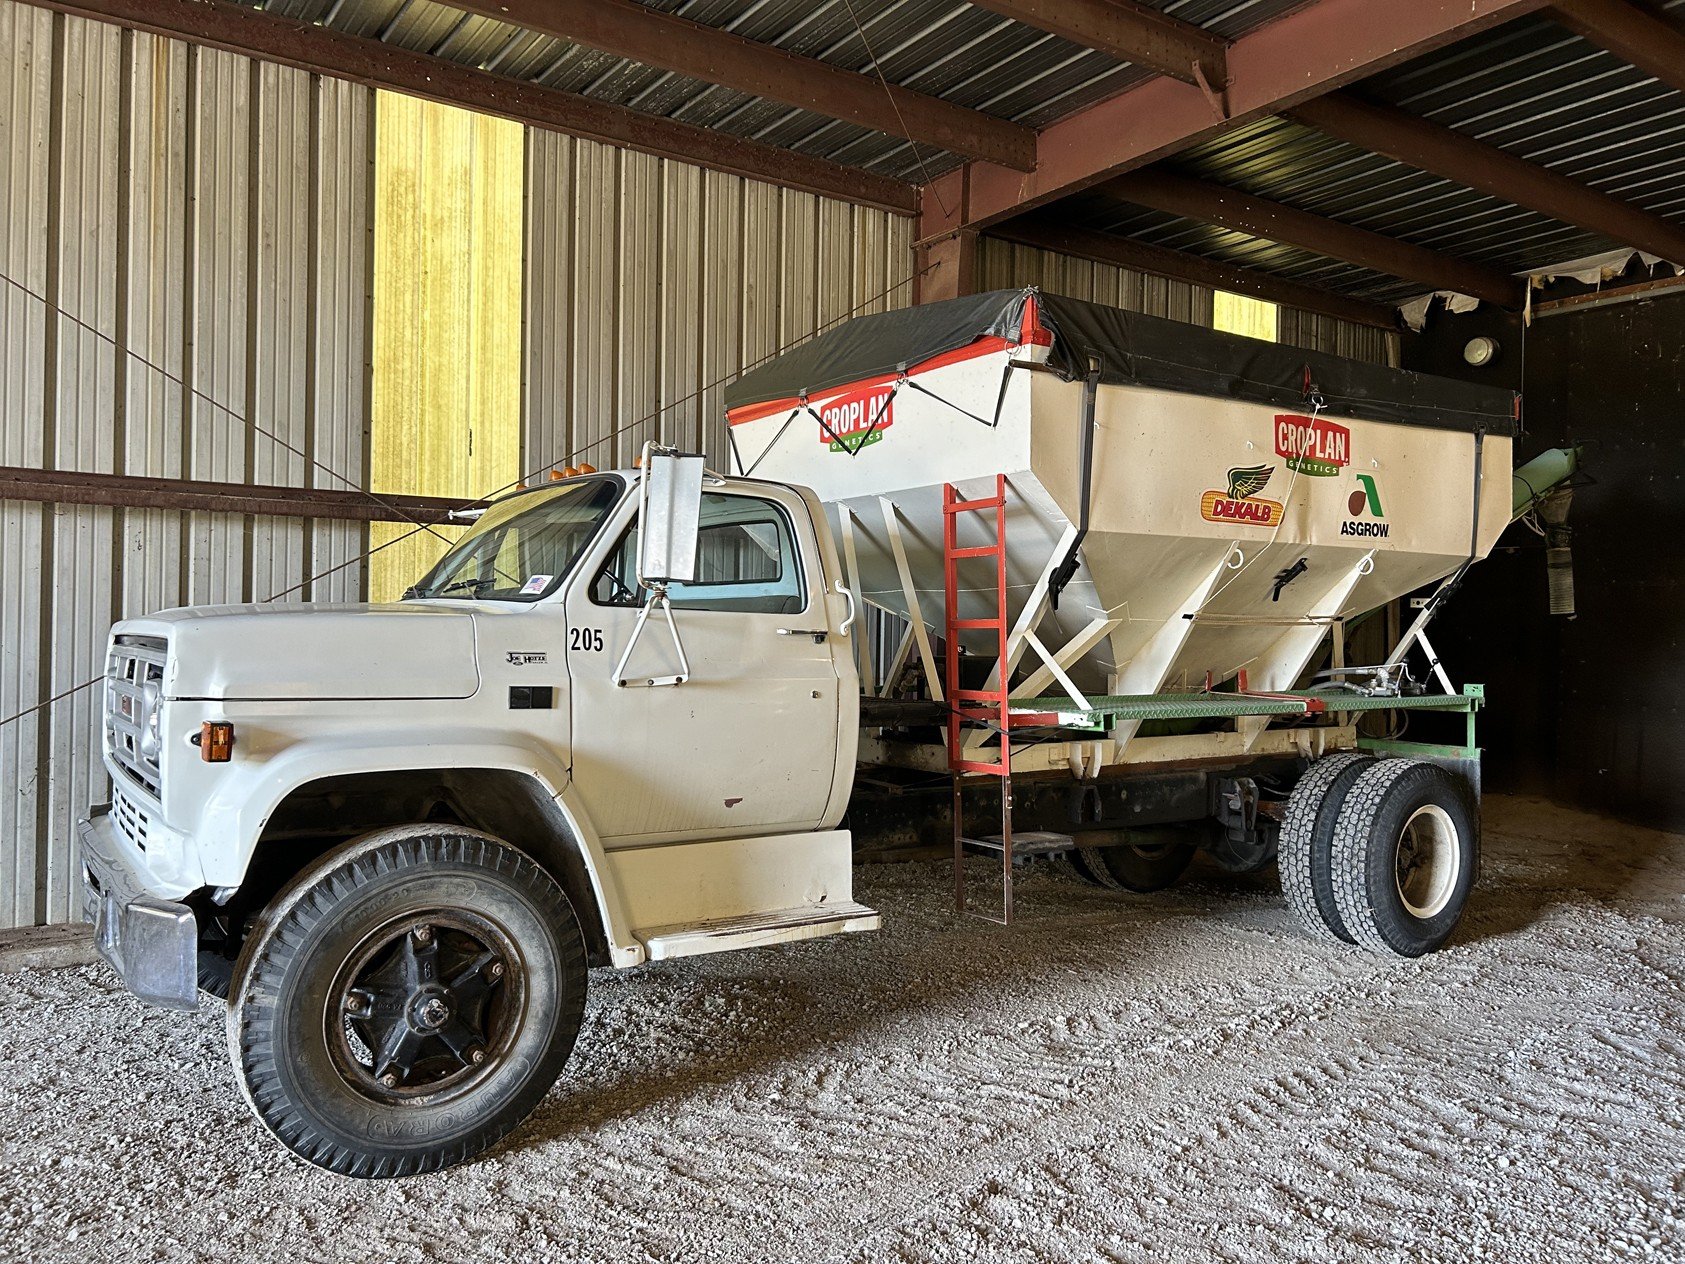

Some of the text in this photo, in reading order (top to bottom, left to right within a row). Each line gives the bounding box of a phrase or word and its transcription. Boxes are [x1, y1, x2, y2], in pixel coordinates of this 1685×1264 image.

[822, 393, 889, 438] CROPLAN
[831, 432, 881, 450] GNETCS
[1278, 421, 1345, 461] CROPLAN
[1212, 499, 1272, 522] DEKALB
[1340, 521, 1389, 538] ASGROW
[570, 627, 604, 651] 205
